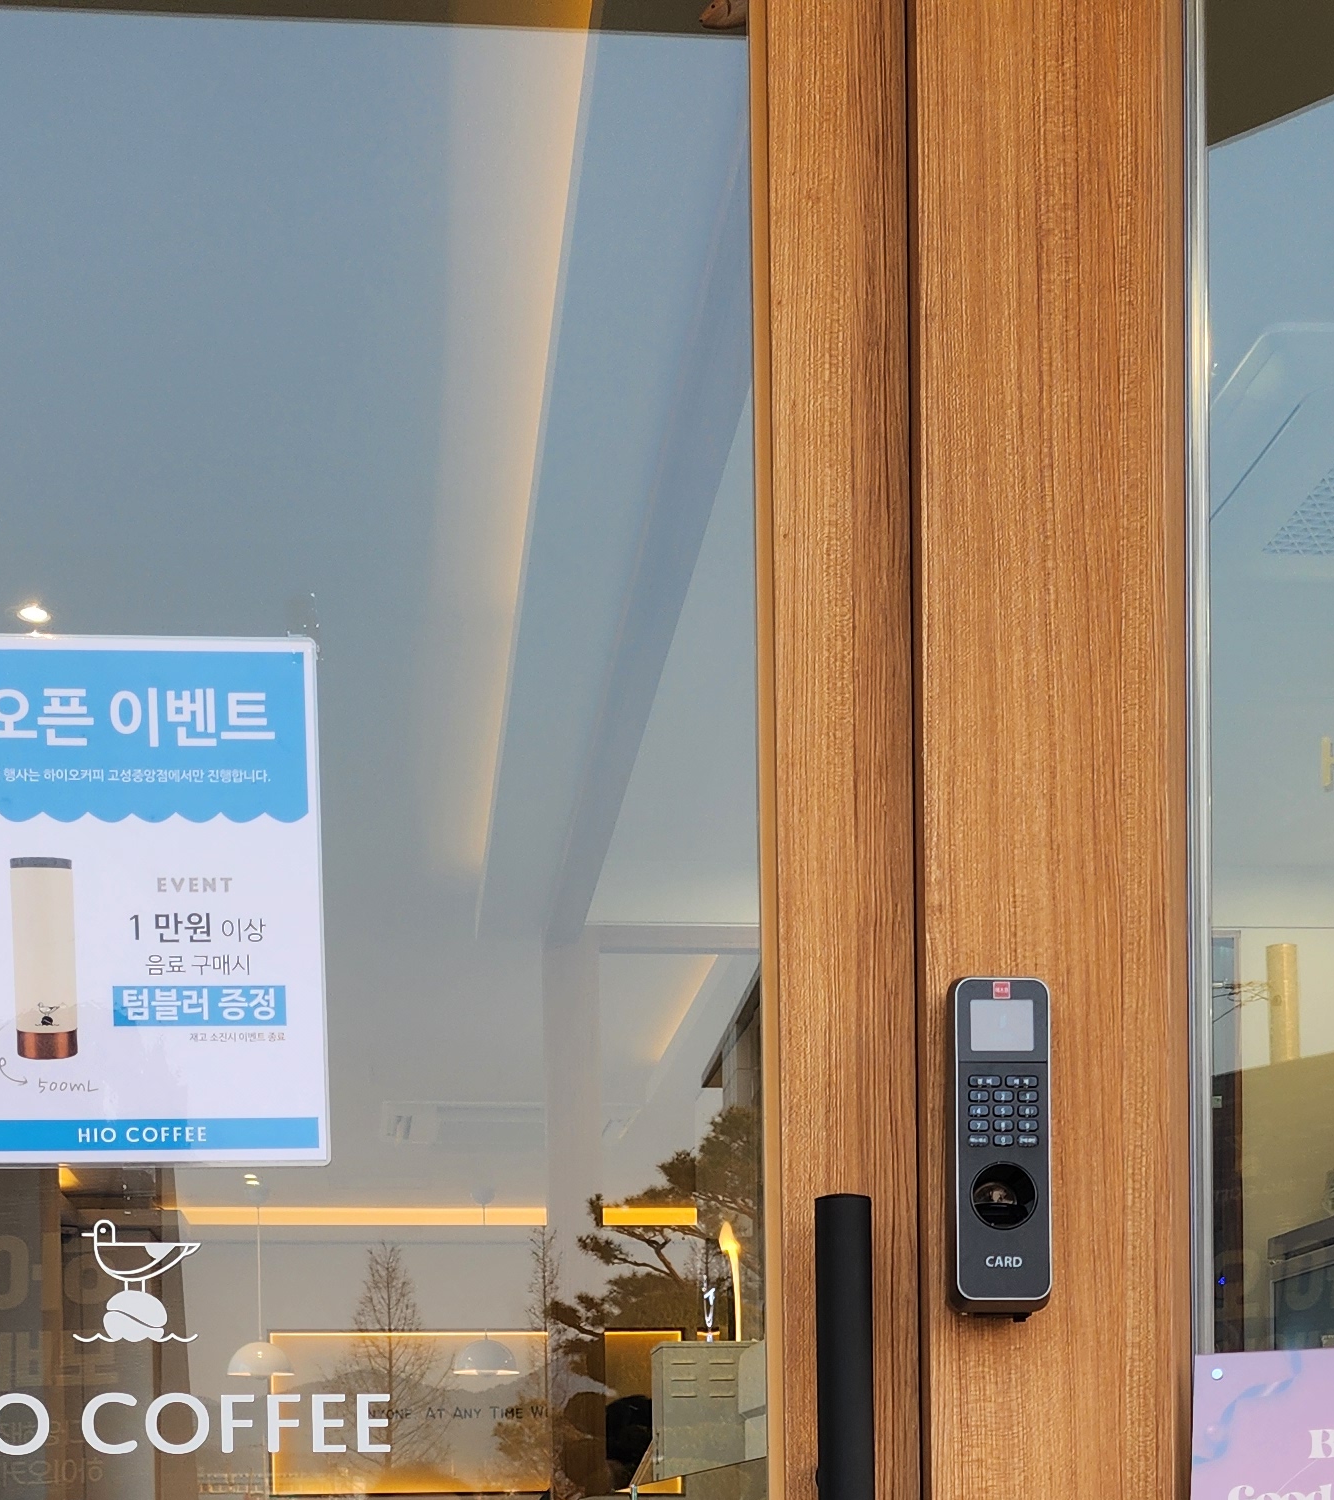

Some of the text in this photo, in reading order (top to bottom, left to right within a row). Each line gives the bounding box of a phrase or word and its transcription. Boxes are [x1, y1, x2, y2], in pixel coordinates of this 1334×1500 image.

[110, 687, 276, 748] 이벤트
[4, 768, 39, 782] 행사는
[44, 768, 104, 783] 하이오커피
[108, 768, 205, 783] 고성중앙점에서만
[207, 768, 271, 783] 진행합니다.
[157, 877, 233, 893] EVENT
[129, 912, 266, 943] 1 만원 이상
[145, 954, 251, 976] 음료 구매시
[122, 987, 276, 1021] 텀블러 증정
[189, 1032, 285, 1042] 재고 소진시 이벤트 종료
[78, 1126, 207, 1144] HIO COFFEE
[985, 1256, 1023, 1268] CARD
[81, 1393, 392, 1455] COFFEE
